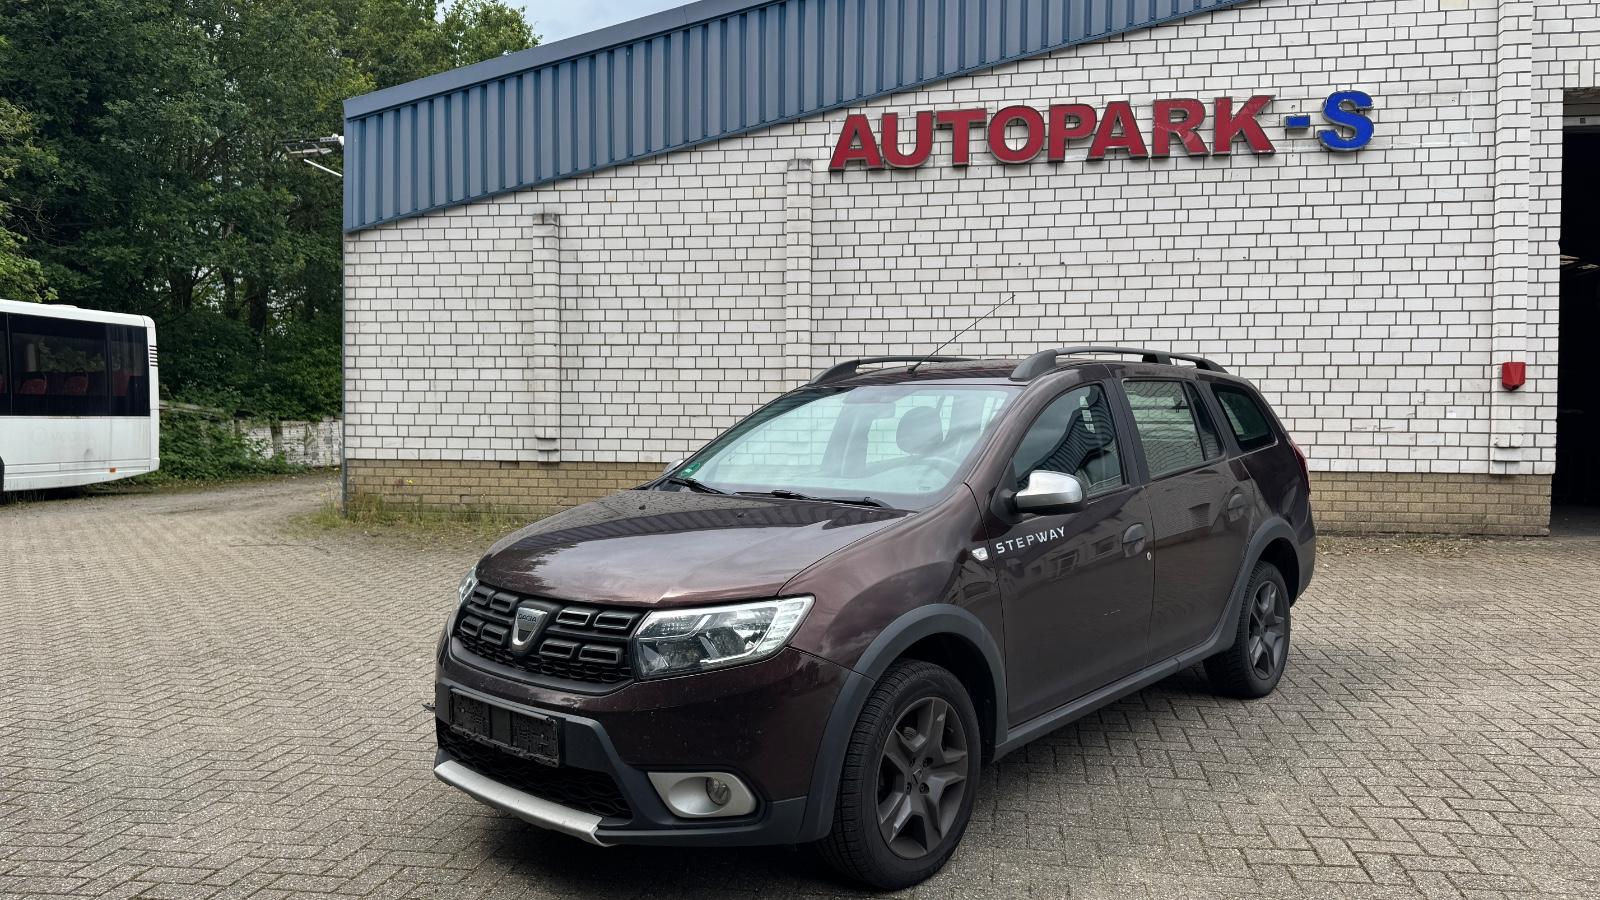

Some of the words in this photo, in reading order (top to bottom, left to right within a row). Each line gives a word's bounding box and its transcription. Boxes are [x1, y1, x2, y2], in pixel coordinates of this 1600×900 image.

[828, 90, 1375, 171] AUTOPARK-S
[995, 526, 1065, 554] STEPWAY
[517, 613, 537, 622] DACIA
